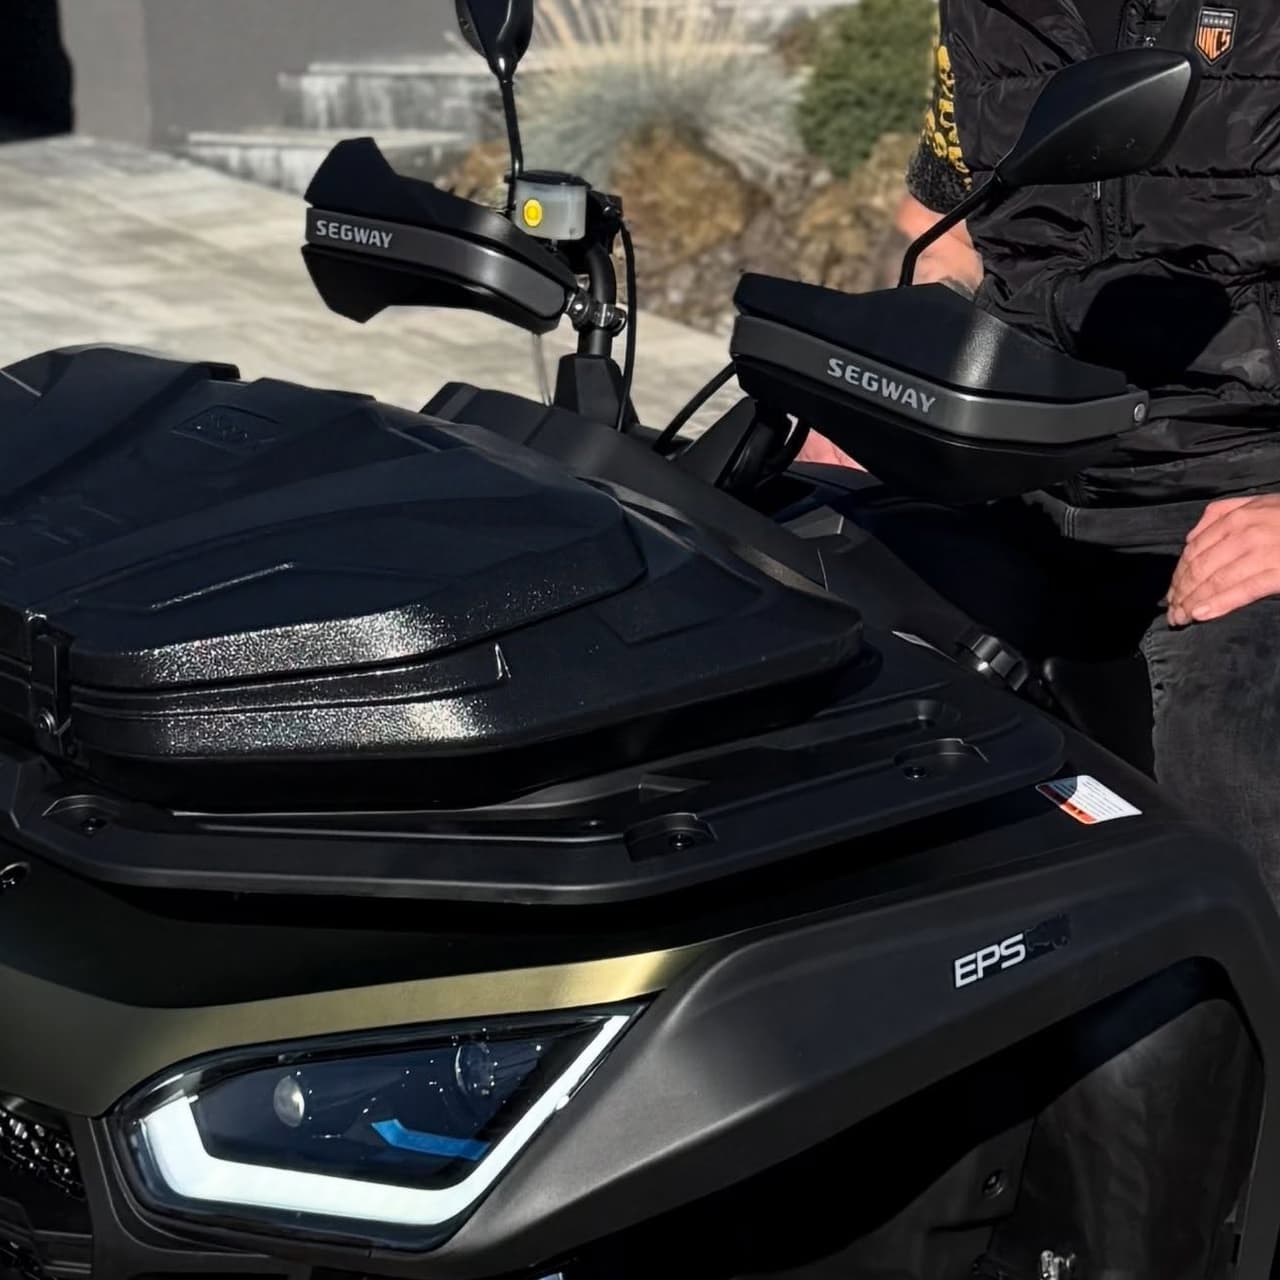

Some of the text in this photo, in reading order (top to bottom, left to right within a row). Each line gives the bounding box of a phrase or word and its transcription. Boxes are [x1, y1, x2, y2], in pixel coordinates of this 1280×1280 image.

[316, 220, 393, 249] SEGWAY
[827, 358, 936, 413] SEGWAY
[954, 931, 1027, 988] EPS
